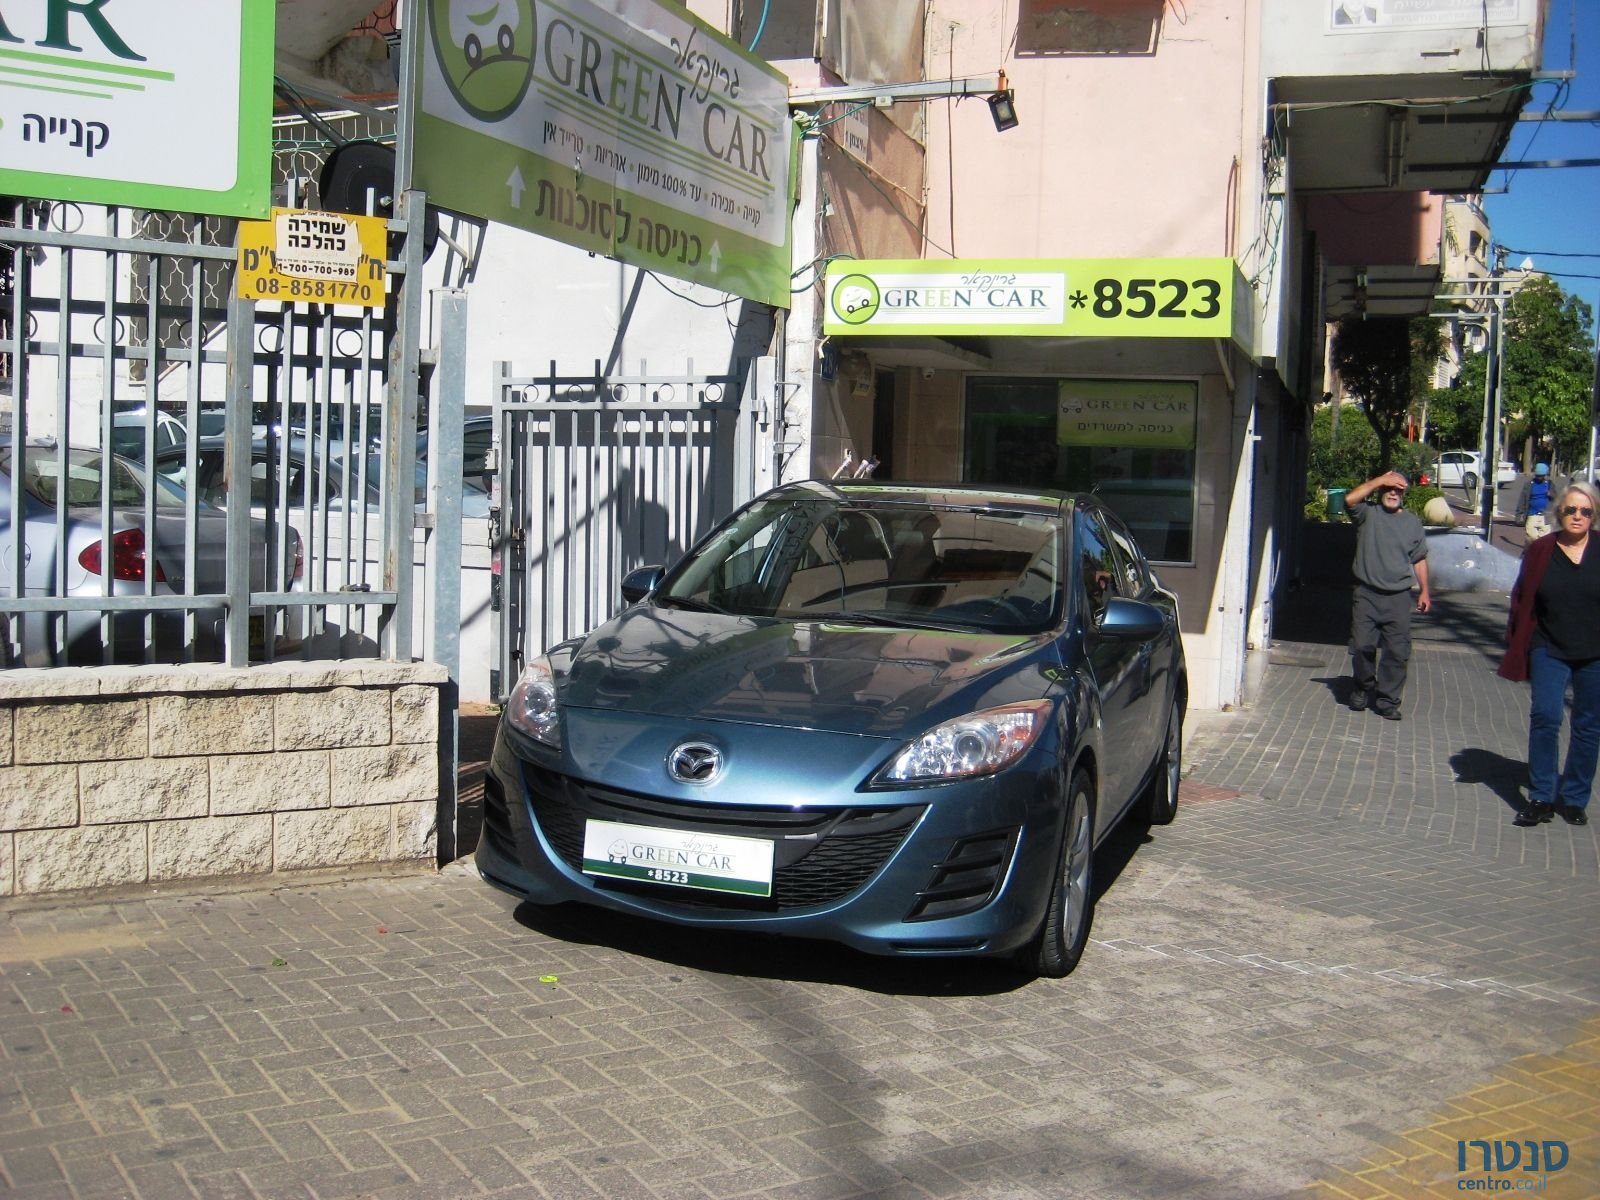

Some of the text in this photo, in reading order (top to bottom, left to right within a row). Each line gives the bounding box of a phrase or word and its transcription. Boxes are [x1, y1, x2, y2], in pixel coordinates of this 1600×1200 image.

[0, 0, 147, 62] R
[544, 18, 771, 182] GREEN CAR
[23, 113, 110, 158] קנייה
[543, 120, 761, 228] קנייה מכירה עד 100% מימון אחריות טרייד אין
[288, 218, 346, 235] שמירה
[535, 178, 702, 267] כניסה לסוכנות
[288, 234, 346, 251] כהלכה
[277, 263, 355, 277] 1-700-700-989
[256, 277, 371, 300] 08-8581770
[884, 287, 1048, 308] GREEN CAR
[1087, 400, 1188, 411] GREEN CAR
[1077, 421, 1174, 433] כניסה למשרדים
[632, 845, 732, 870] GREEN CAR
